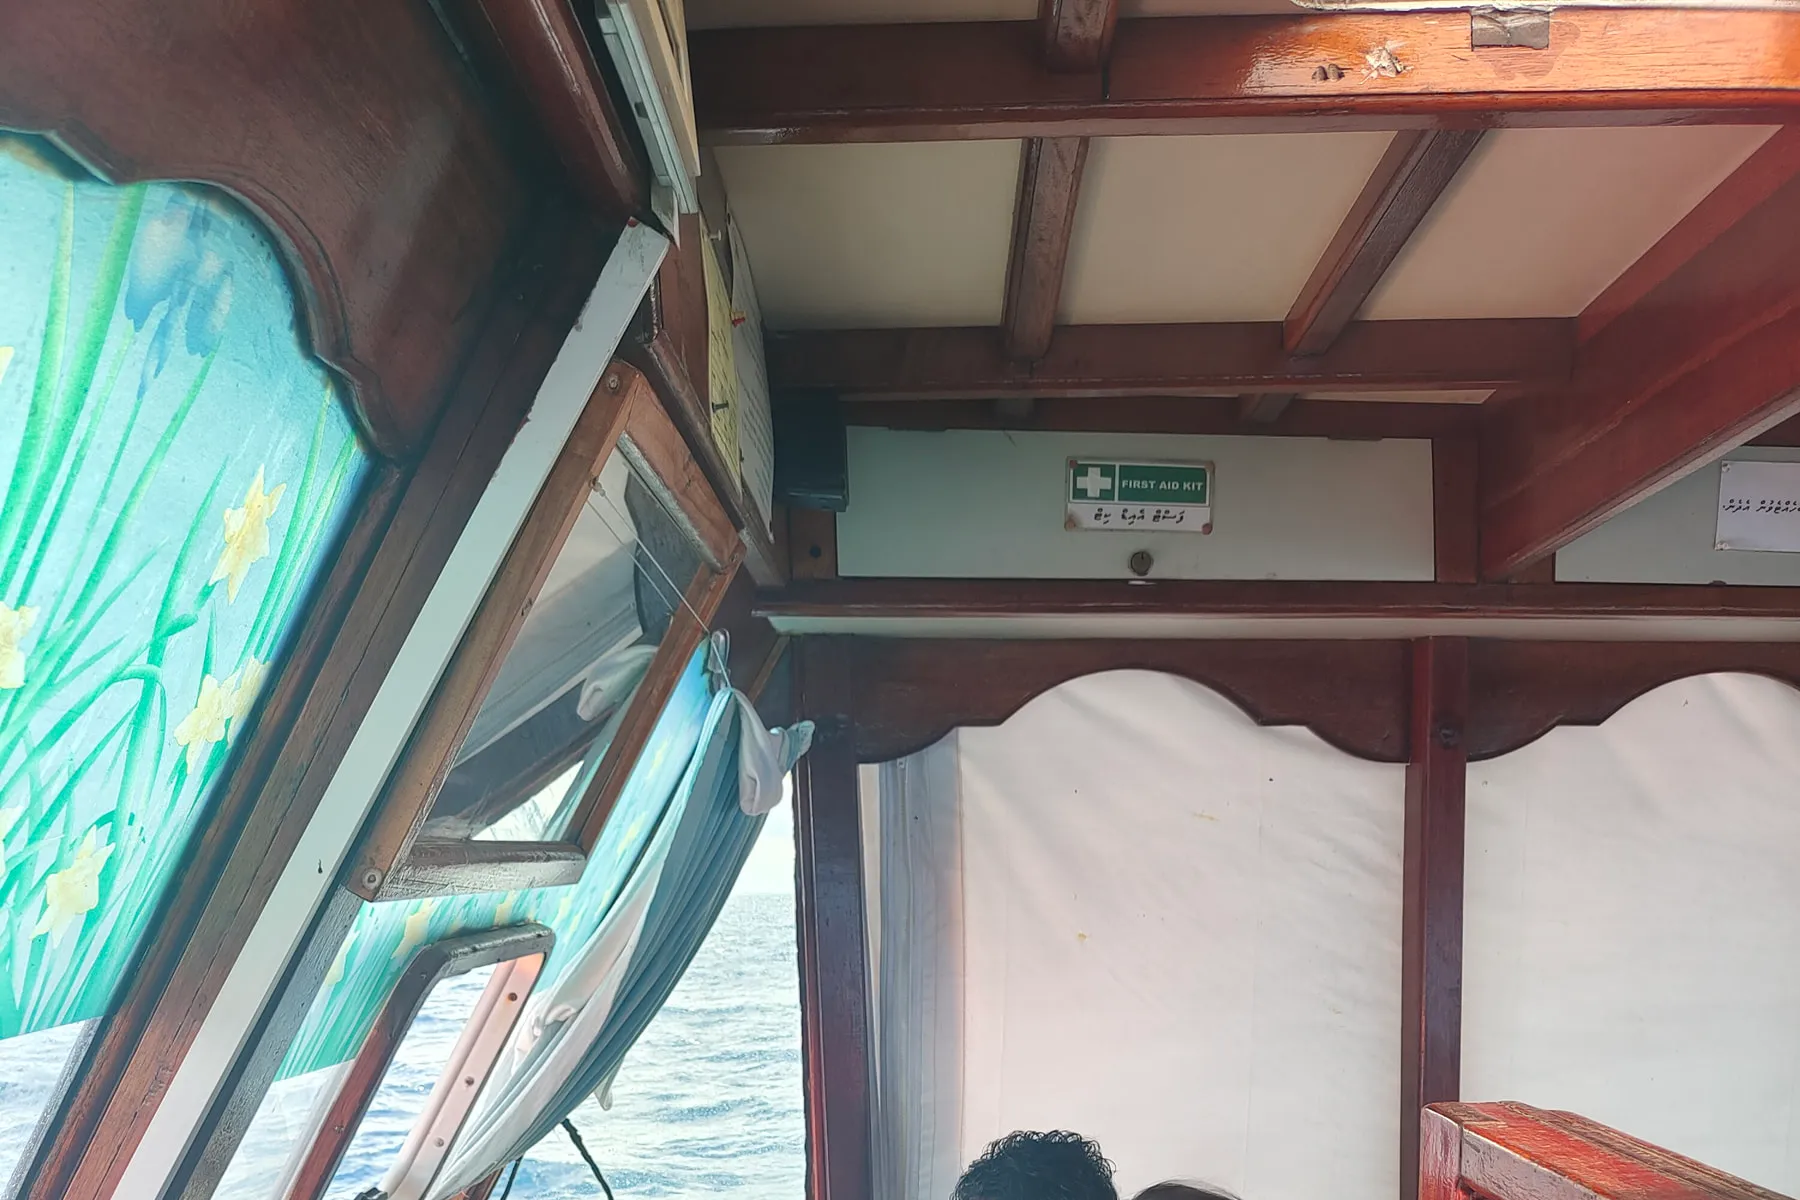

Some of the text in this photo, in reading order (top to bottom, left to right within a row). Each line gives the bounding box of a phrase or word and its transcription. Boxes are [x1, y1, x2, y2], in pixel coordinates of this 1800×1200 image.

[1121, 480, 1204, 492] FIRST AID KIT
